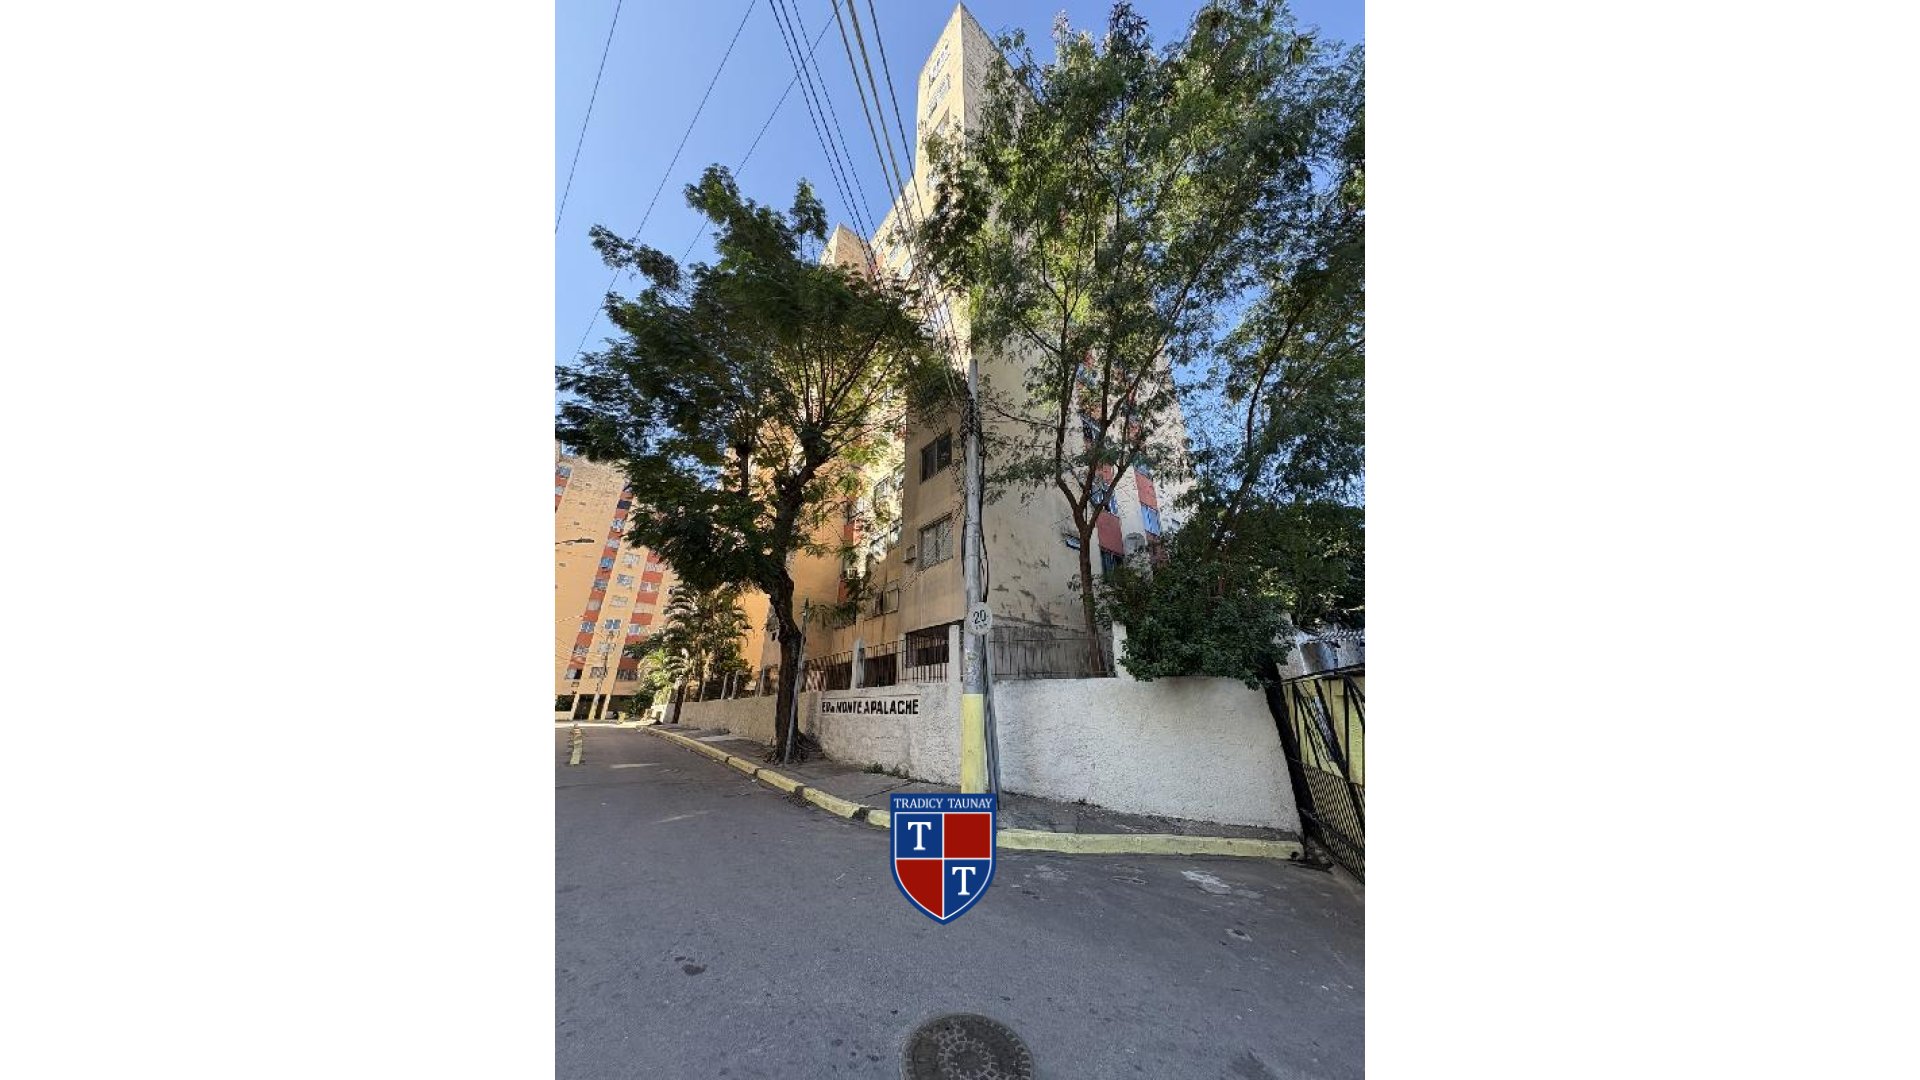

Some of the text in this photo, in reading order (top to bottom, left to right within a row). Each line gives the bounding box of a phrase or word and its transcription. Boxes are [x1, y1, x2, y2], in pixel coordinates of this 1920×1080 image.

[973, 609, 987, 625] 20
[836, 701, 862, 714] MONTE
[863, 699, 919, 715] APALACHE
